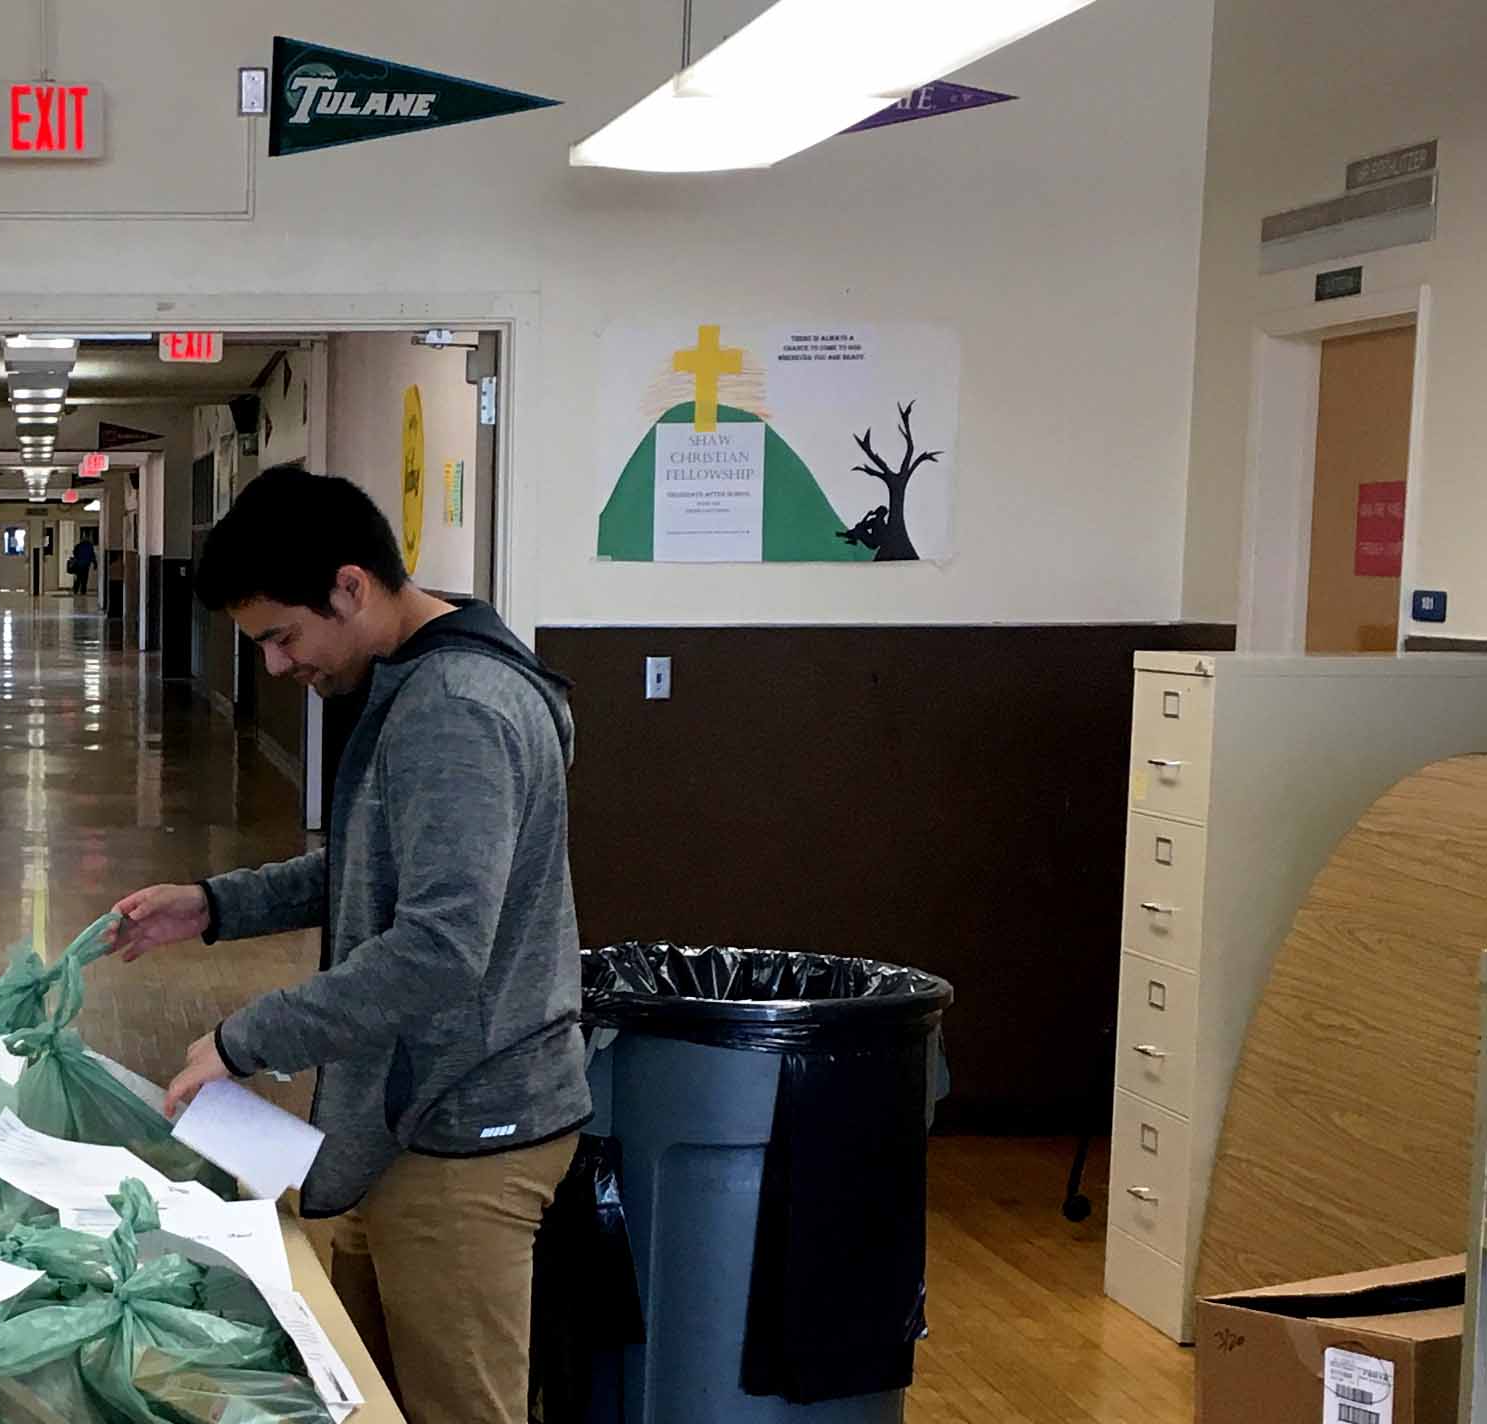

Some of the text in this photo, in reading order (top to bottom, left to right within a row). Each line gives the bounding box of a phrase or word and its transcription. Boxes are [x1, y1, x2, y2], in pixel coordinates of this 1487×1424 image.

[10, 84, 90, 151] EXIT
[688, 434, 732, 446] SHAW
[670, 451, 750, 463] CHRISTIAN
[666, 469, 754, 481] FELLOWSHIP
